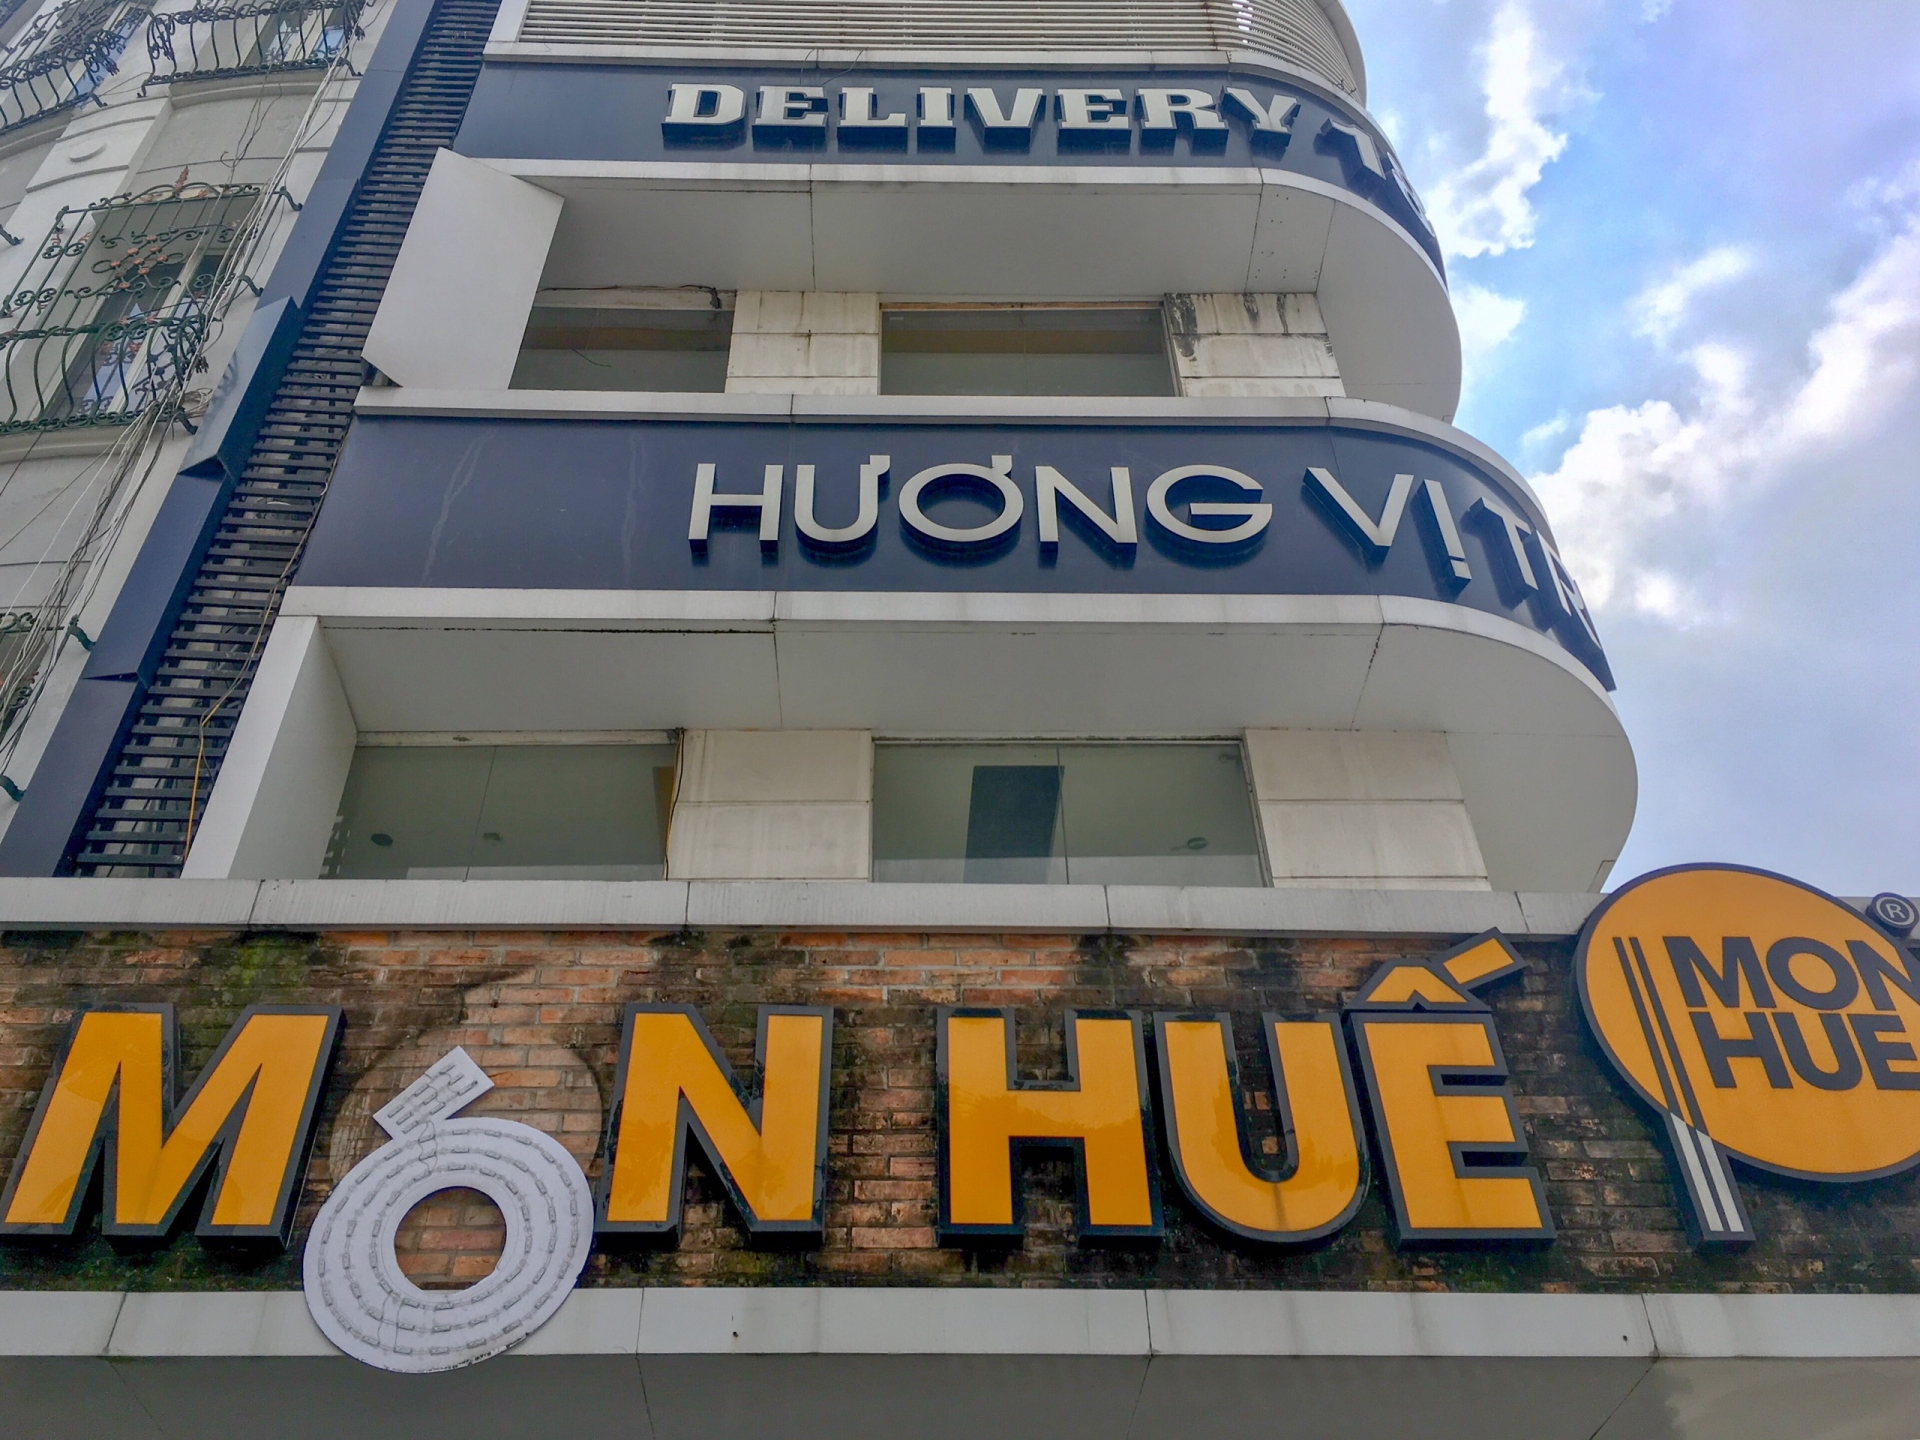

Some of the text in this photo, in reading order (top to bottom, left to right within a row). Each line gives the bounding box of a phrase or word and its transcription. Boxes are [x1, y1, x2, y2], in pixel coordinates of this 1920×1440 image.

[664, 82, 1299, 148] DELIVERY
[689, 454, 1273, 551] HƯƠNG
[1303, 466, 1472, 586] VỊ
[1662, 936, 1920, 1011] MON
[937, 927, 1557, 1246] HUẾ
[1689, 1011, 1920, 1091] HUE
